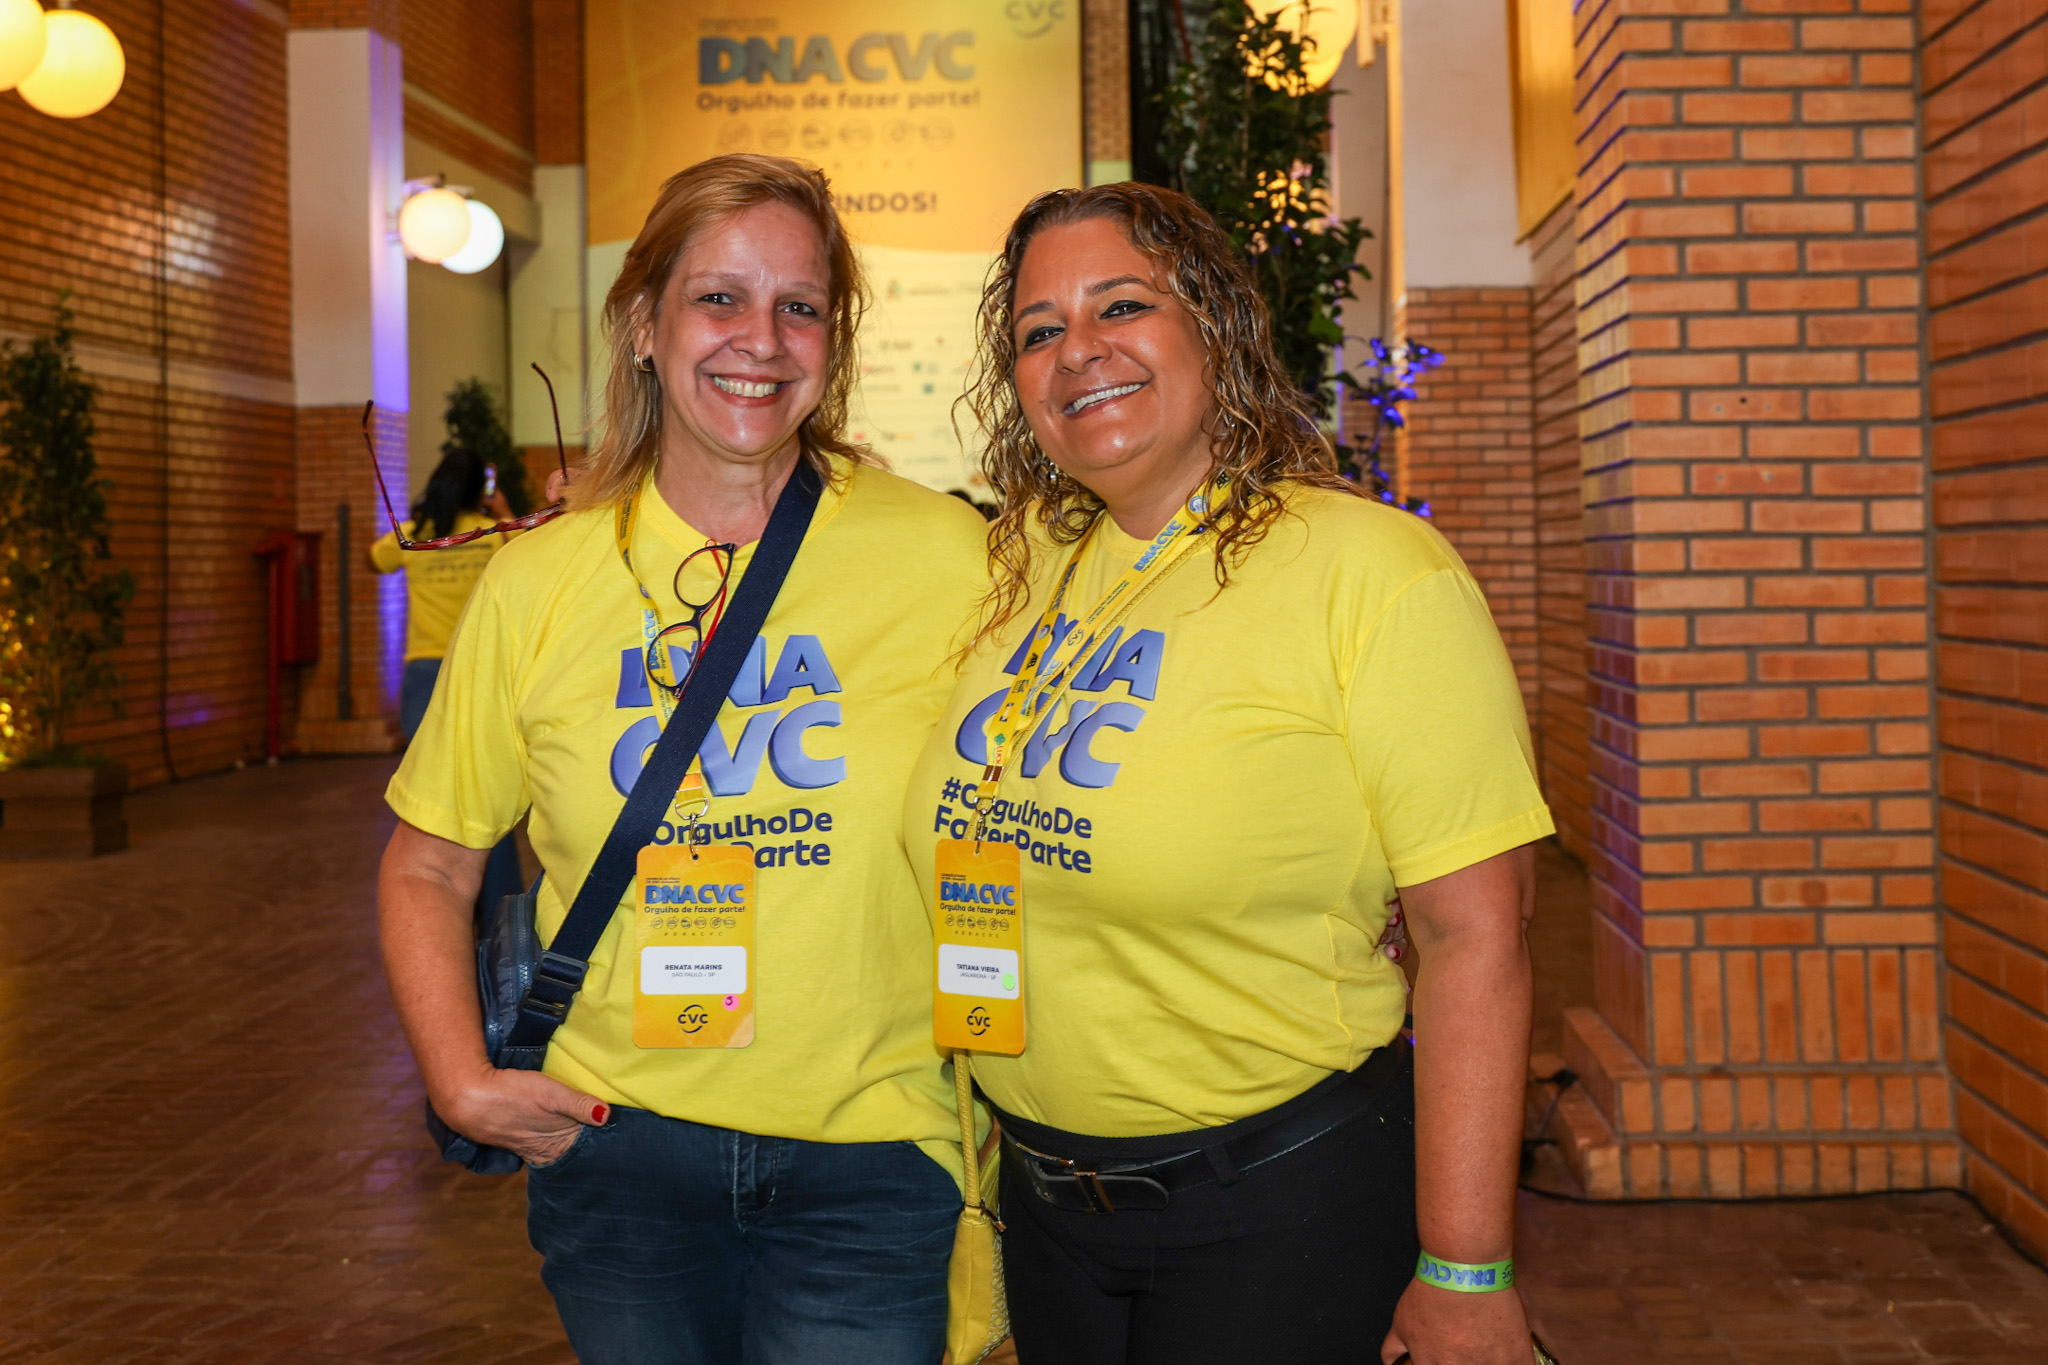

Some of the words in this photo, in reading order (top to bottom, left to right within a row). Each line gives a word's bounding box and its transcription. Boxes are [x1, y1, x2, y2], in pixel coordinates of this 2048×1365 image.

[696, 91, 796, 113] Orgulho
[802, 92, 831, 110] de
[836, 90, 900, 109] fazer
[609, 699, 848, 798] CVC
[955, 685, 1147, 789] CVC
[942, 776, 1093, 839] #OgulhoDe
[934, 804, 1092, 874] FaerParte
[731, 840, 831, 869] arte
[644, 906, 680, 914] Orgulho
[719, 906, 745, 914] parte!
[940, 902, 966, 912] Orgulho
[977, 905, 995, 914] fazer
[996, 908, 1017, 916] parte!
[956, 963, 980, 971] TATIANA
[677, 1013, 709, 1025] CVC
[966, 1014, 991, 1028] CVC
